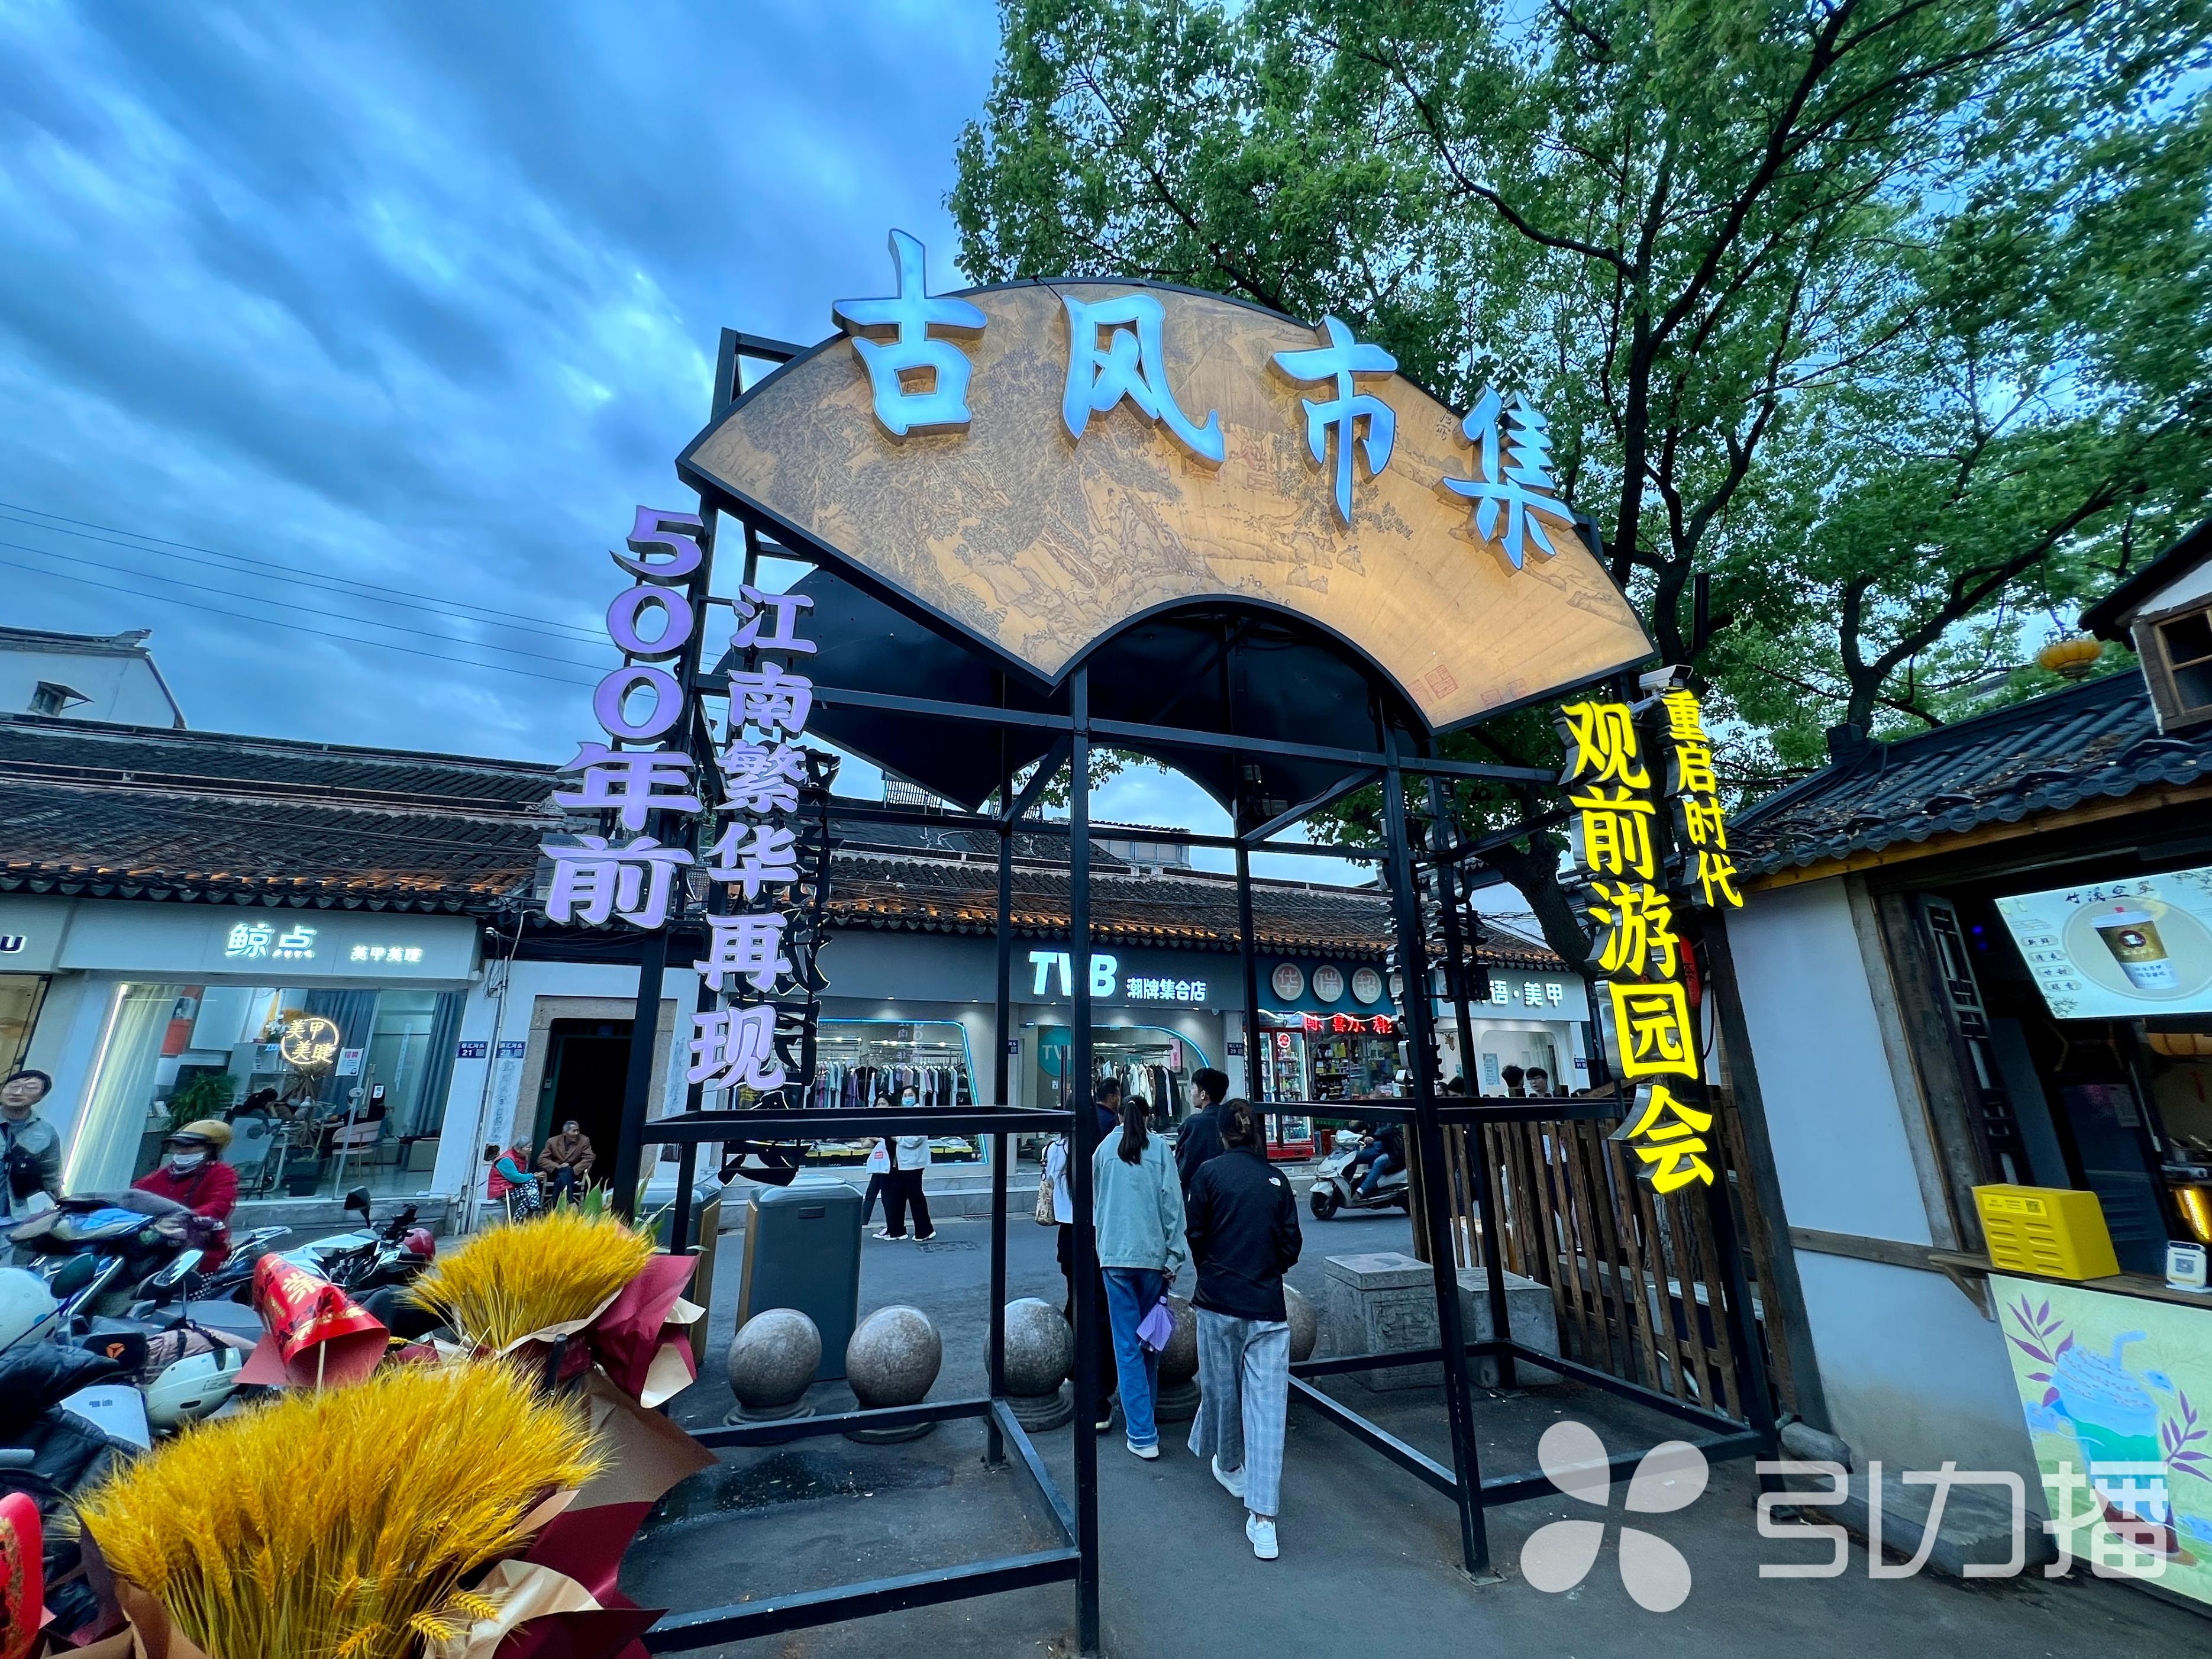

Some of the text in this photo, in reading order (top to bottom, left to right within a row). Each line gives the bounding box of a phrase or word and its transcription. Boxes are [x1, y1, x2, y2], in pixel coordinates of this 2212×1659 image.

[833, 229, 1575, 569] 古风市集
[538, 505, 704, 929] 500年前
[1662, 689, 1744, 909] 重启时代
[687, 584, 817, 1091] 江南繁华再现
[225, 922, 317, 958] 鲸点
[350, 945, 422, 963] 美甲美睫
[1560, 701, 1714, 1194] 观前游园会
[1126, 977, 1207, 1002] 潮牌集合店
[285, 1019, 325, 1040] 美甲
[292, 1040, 337, 1064] 美睫
[1042, 1045, 1072, 1059] TV
